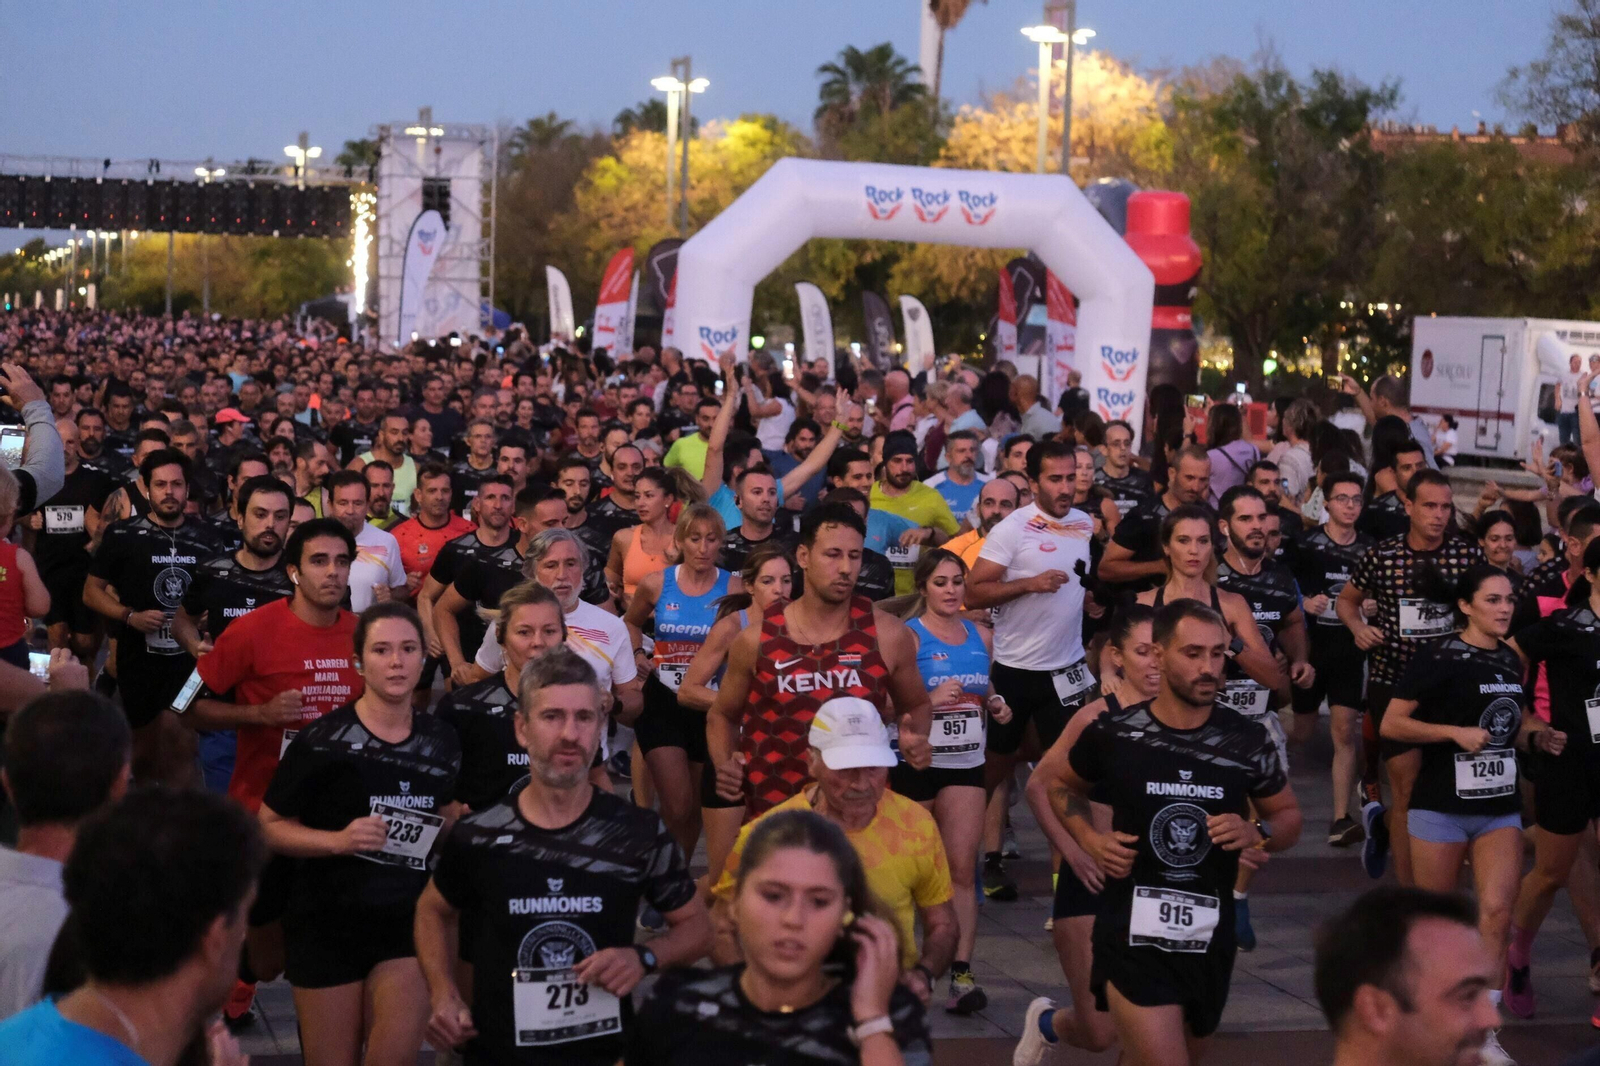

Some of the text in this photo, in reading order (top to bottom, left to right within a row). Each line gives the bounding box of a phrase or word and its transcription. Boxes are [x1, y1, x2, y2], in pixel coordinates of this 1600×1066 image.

[865, 186, 997, 210] Rock Rock Rock
[699, 326, 737, 347] Rock
[1101, 345, 1138, 366] Rock
[1097, 387, 1135, 408] Rock
[152, 556, 196, 564] RUNMONES
[304, 659, 349, 669] XL CARRERA
[315, 672, 339, 682] MARIA
[778, 669, 862, 694] KENYA
[302, 686, 351, 695] AUXILIADORA
[1480, 683, 1523, 694] RUNMONES
[1232, 692, 1256, 706] 958
[943, 720, 967, 735] 957
[1471, 760, 1505, 778] 1240
[1146, 782, 1224, 799] RUNMONES
[369, 796, 435, 808] RUNMONES
[386, 819, 424, 844] 1233
[509, 896, 603, 914] RUNMONES
[1159, 902, 1193, 926] 915
[546, 982, 589, 1010] 273
